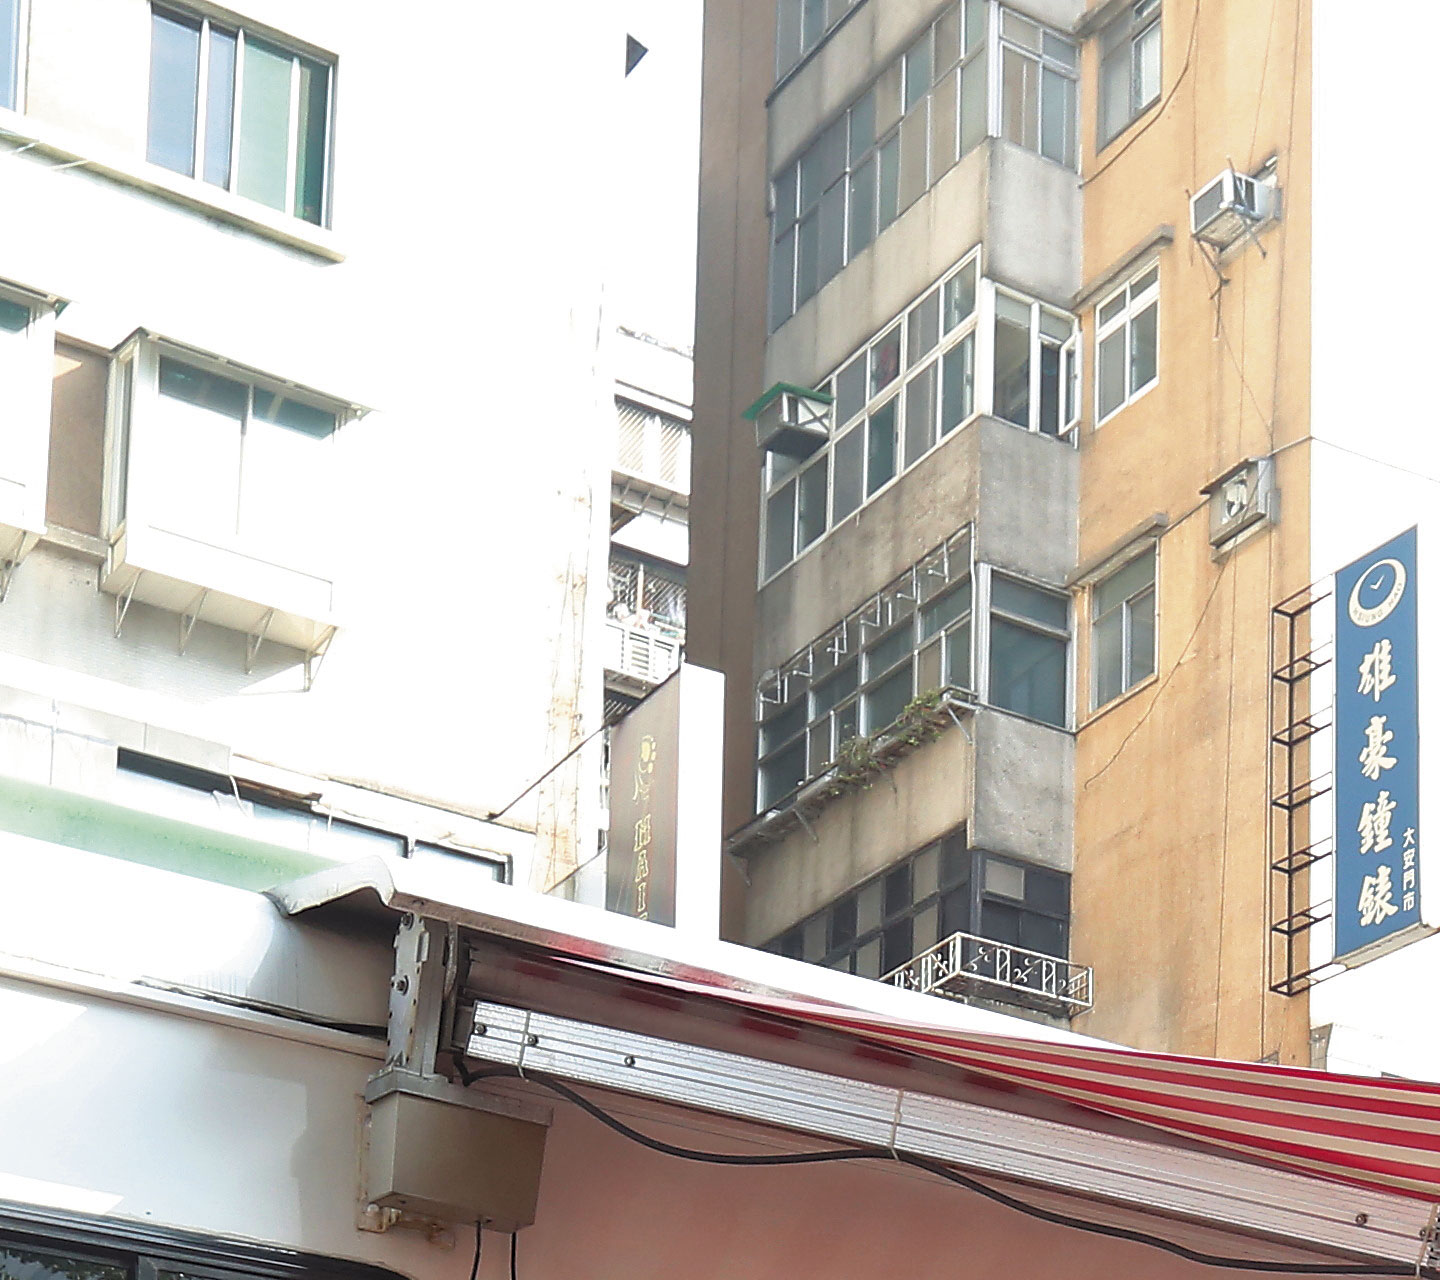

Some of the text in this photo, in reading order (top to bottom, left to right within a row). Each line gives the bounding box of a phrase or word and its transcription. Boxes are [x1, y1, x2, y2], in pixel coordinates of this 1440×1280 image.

[1356, 638, 1400, 926] 雄豪鐘錶
[633, 813, 652, 921] HAI
[1401, 826, 1417, 911] 大安門市
